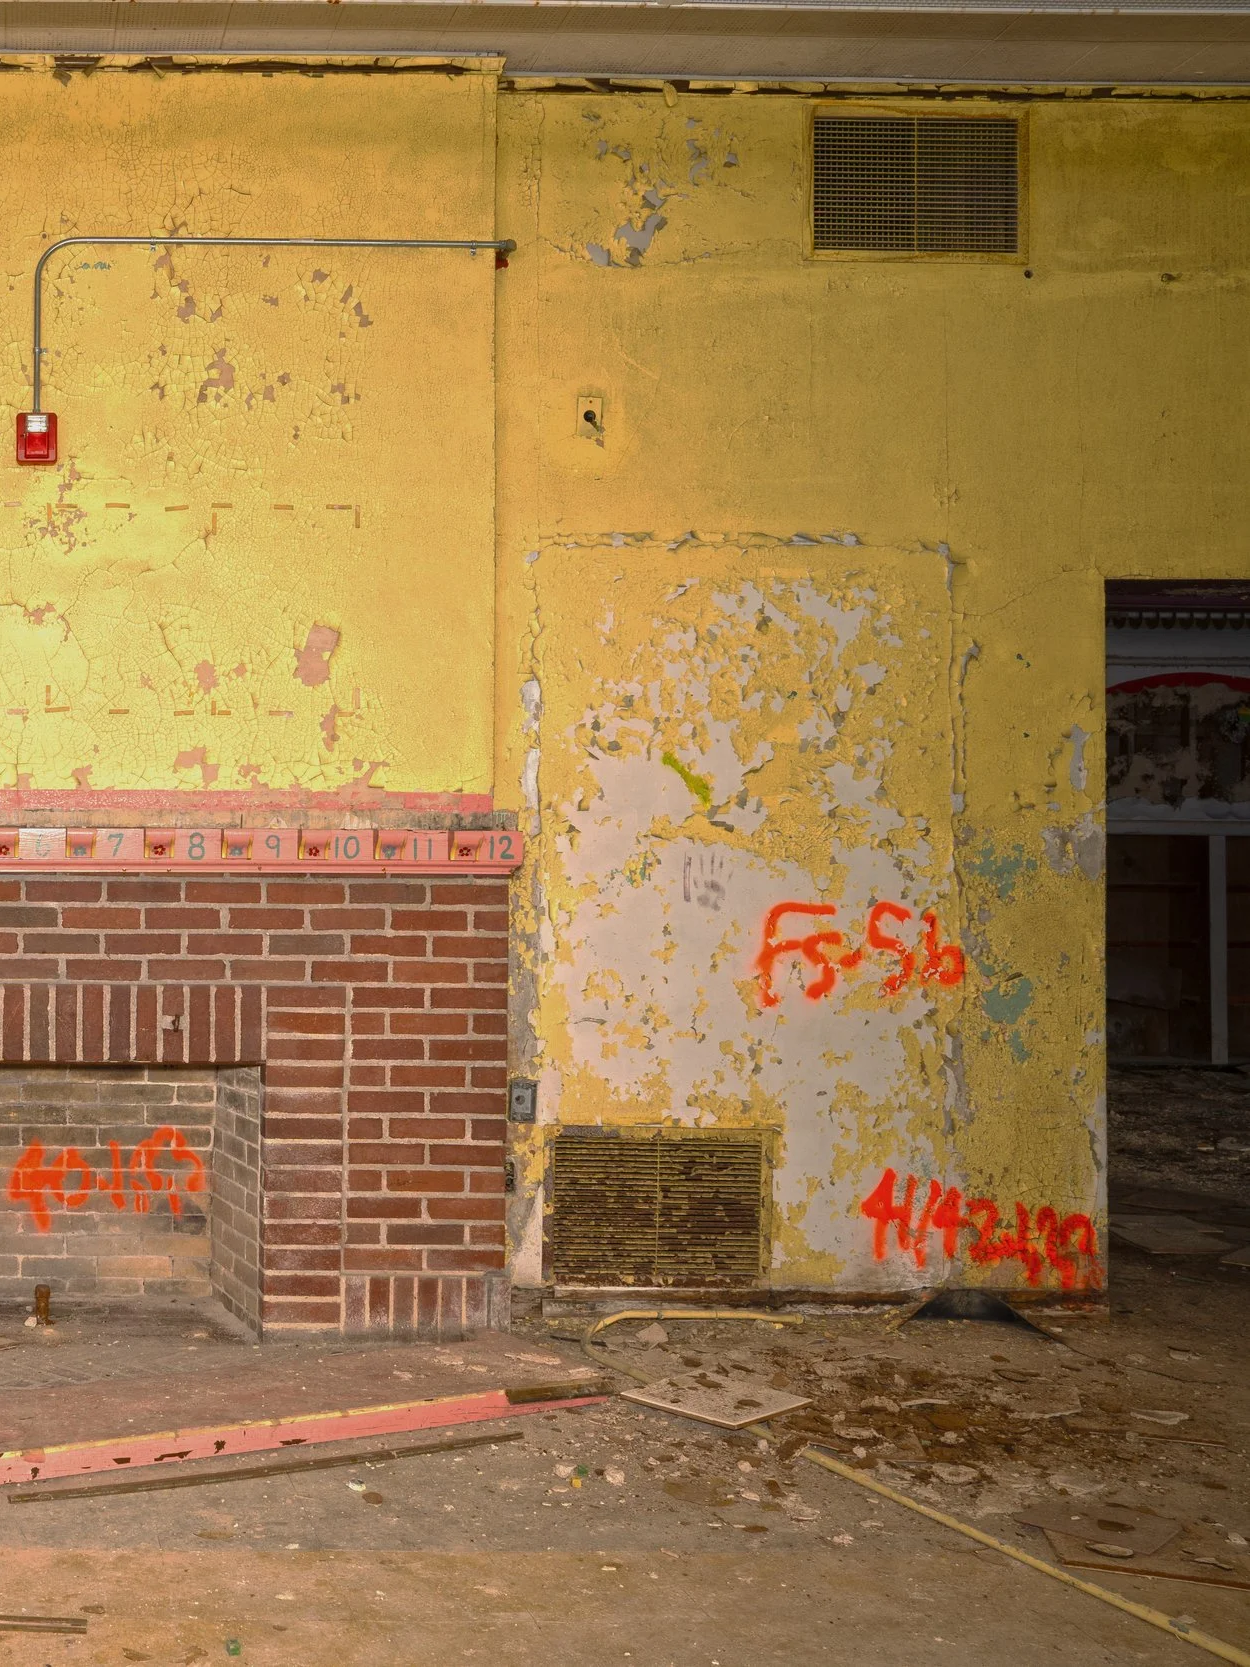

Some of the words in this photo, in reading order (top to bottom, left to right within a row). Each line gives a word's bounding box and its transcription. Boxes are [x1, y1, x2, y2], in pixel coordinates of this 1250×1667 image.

[107, 832, 125, 857] 7
[187, 832, 206, 861] 8
[265, 834, 281, 859] 9
[334, 835, 361, 859] 10
[412, 836, 433, 860] 11
[489, 835, 516, 861] 12
